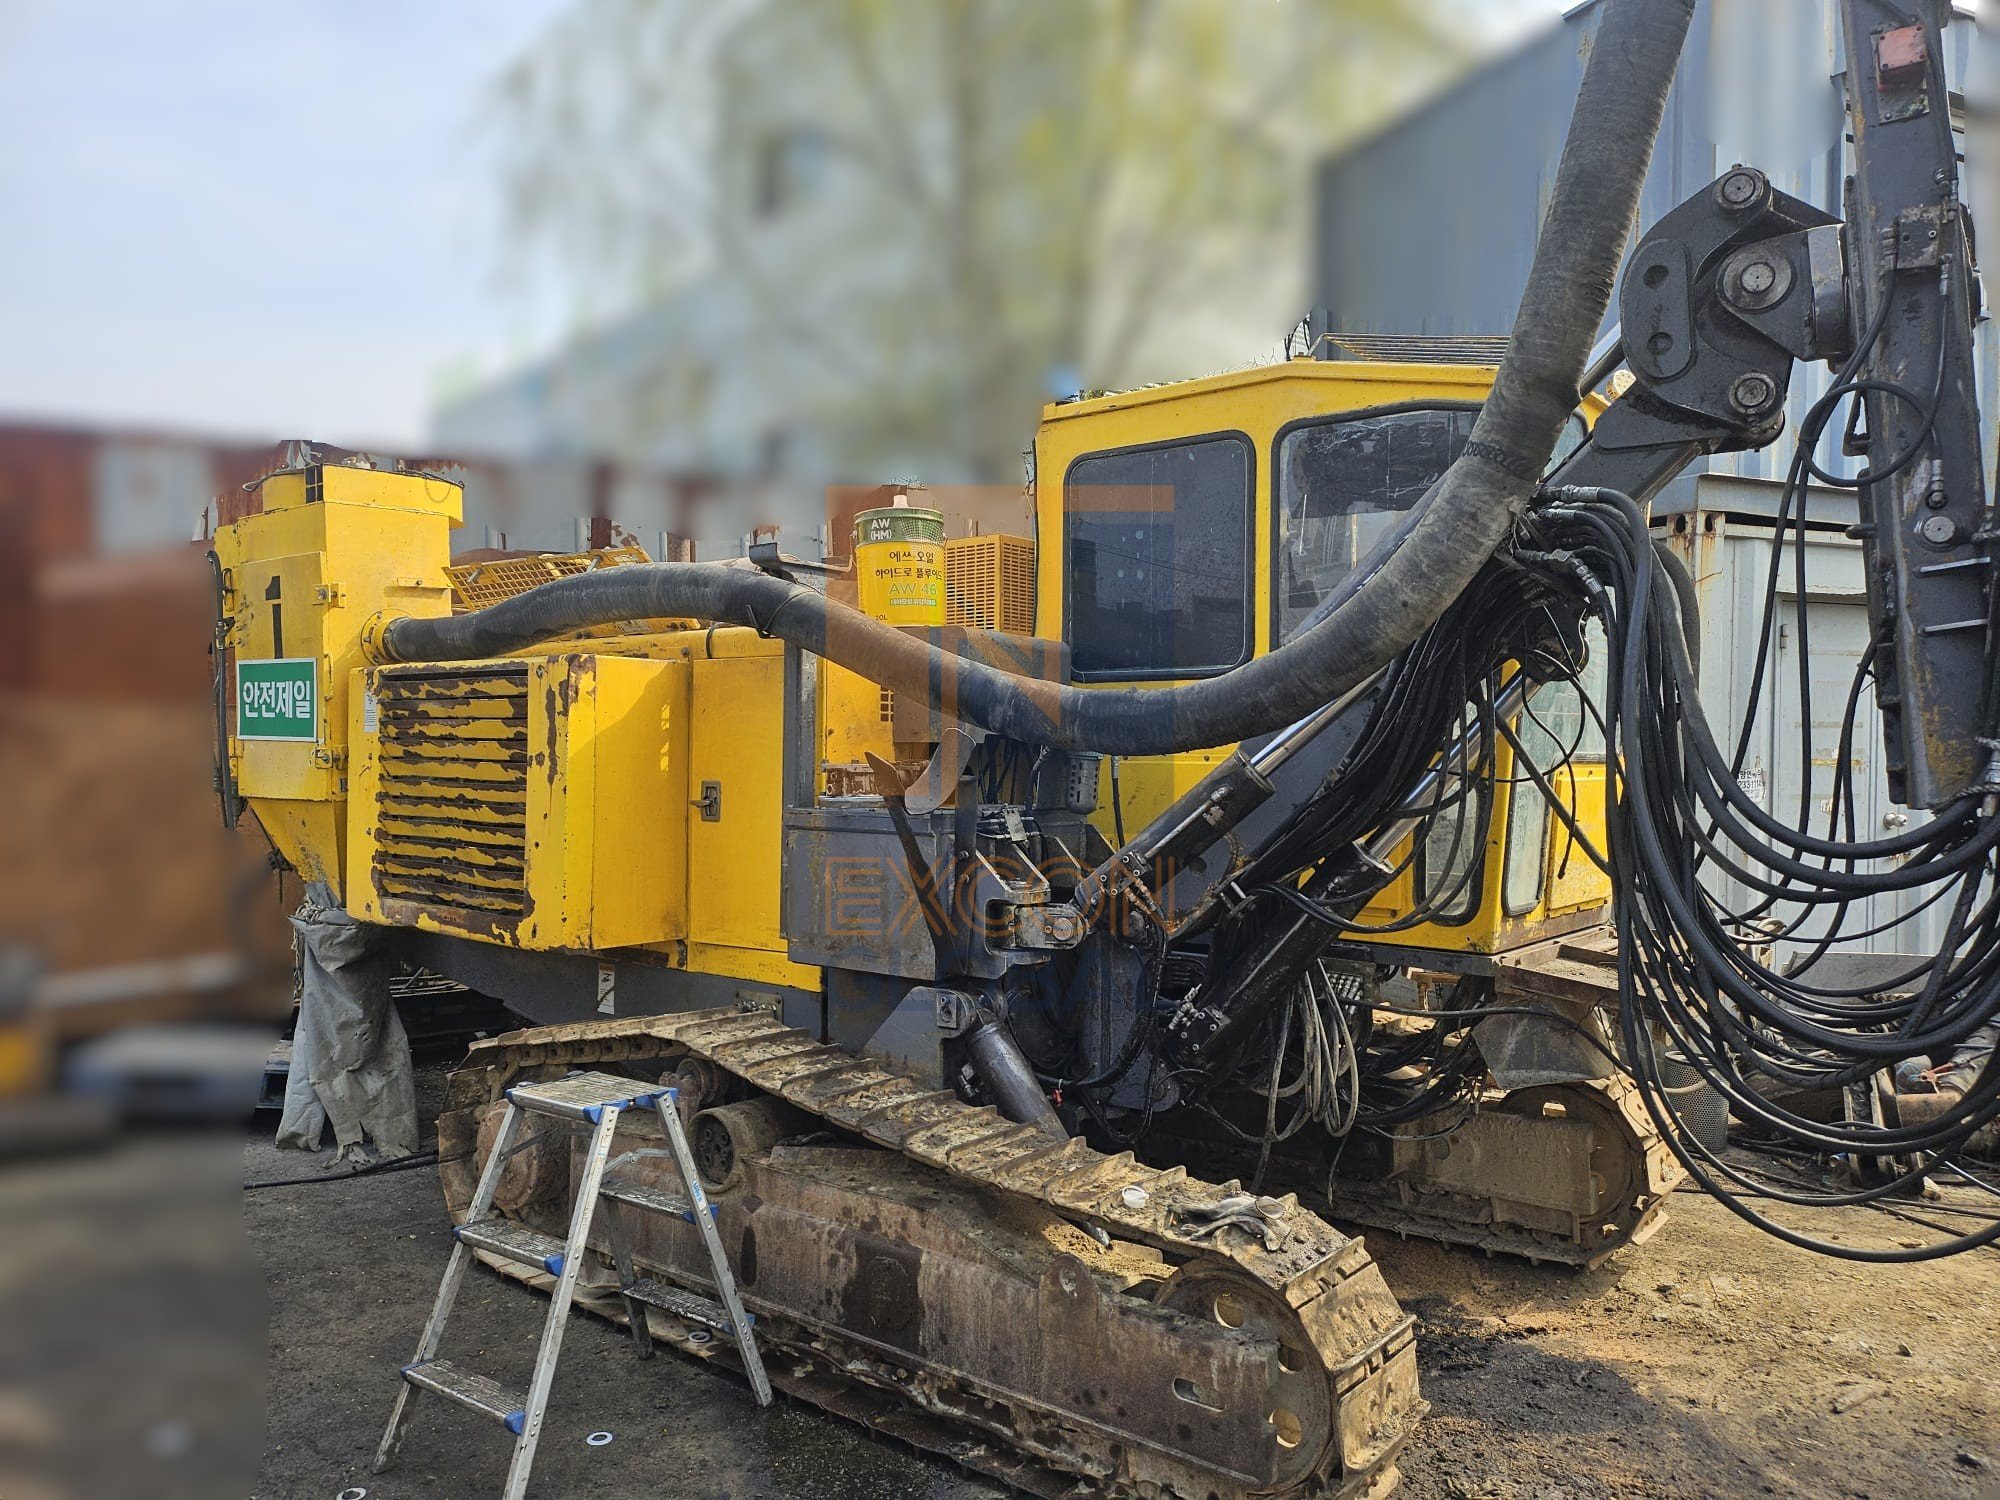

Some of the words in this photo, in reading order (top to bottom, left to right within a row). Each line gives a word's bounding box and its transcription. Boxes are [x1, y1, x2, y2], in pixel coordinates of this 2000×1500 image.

[871, 518, 891, 530] AW
[870, 529, 892, 541] (HM)
[889, 551, 913, 563] 에쓰
[916, 551, 934, 564] 오일
[875, 567, 913, 579] 하이드로
[915, 567, 943, 581] 플루이드
[889, 582, 917, 595] AW
[921, 583, 937, 596] 46
[242, 680, 312, 719] 안전제일
